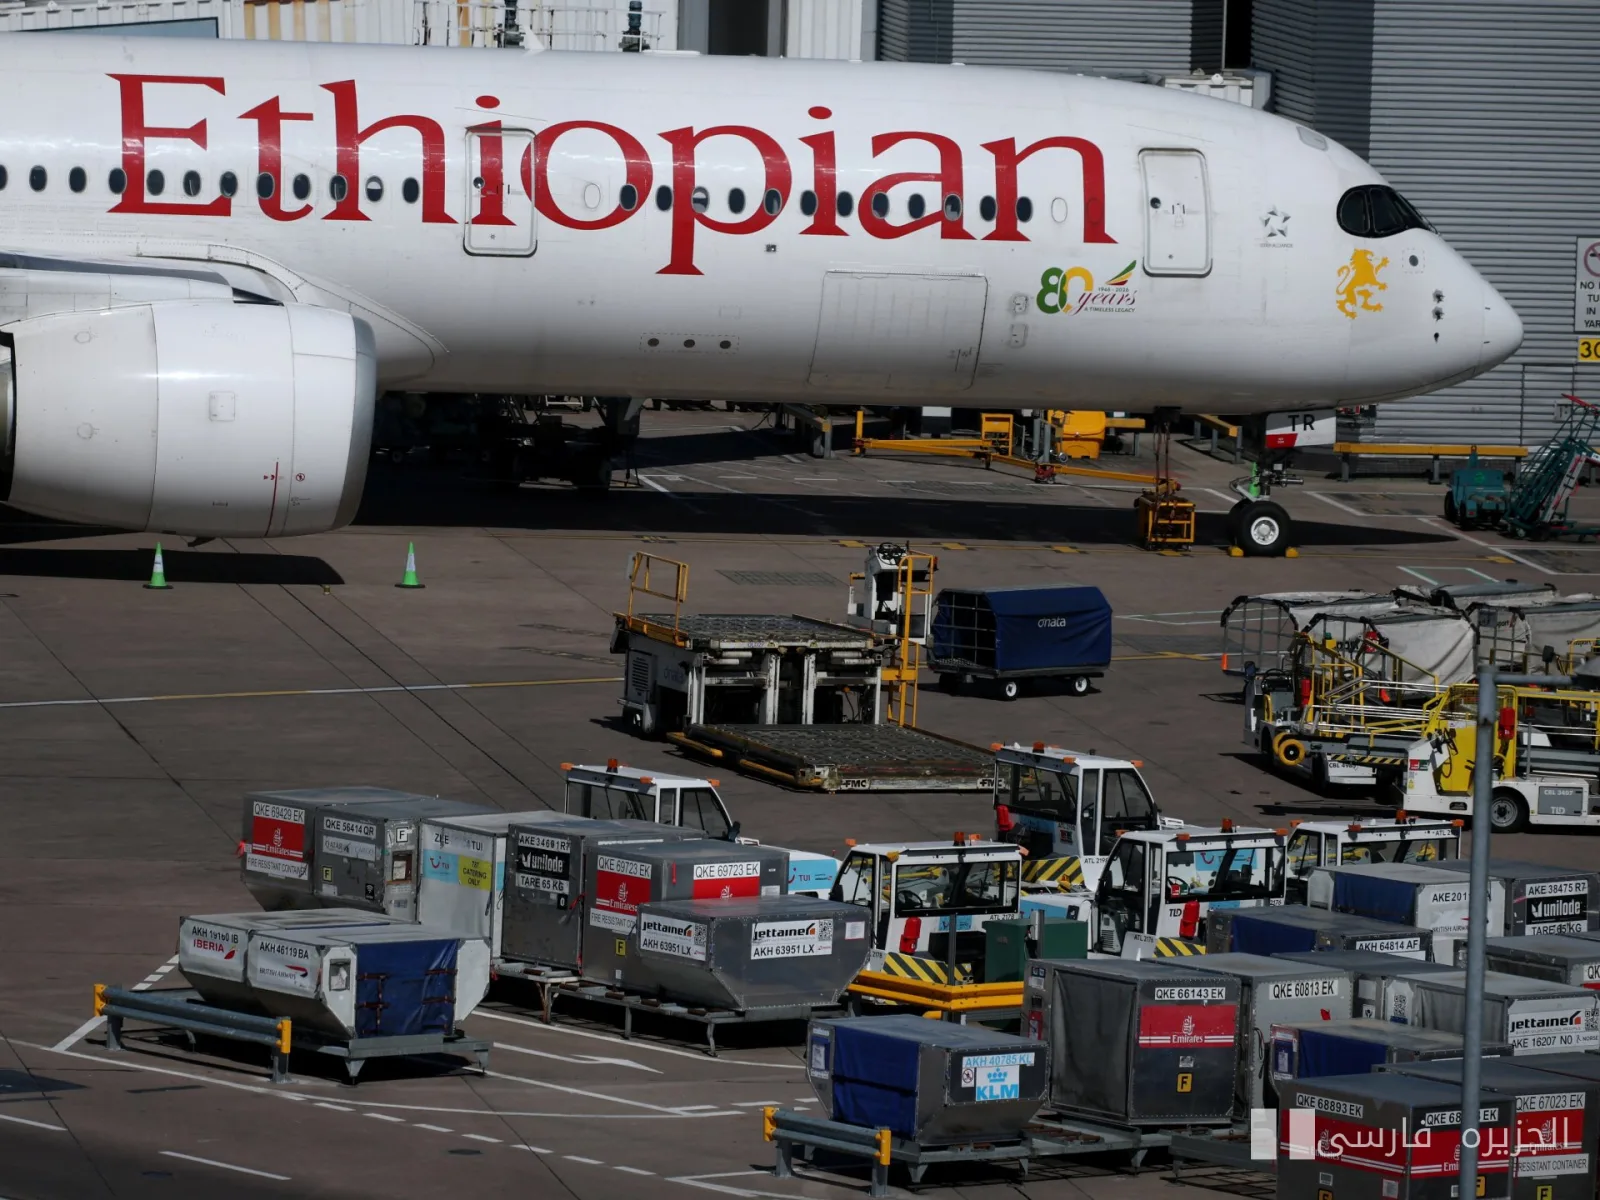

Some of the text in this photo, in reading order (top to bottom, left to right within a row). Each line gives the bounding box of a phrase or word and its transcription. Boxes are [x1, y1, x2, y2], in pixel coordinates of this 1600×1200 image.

[105, 73, 1119, 275] Ethiopian
[1037, 267, 1093, 315] 80
[1580, 281, 1595, 290] NO
[1069, 291, 1138, 316] years
[1586, 307, 1597, 315] IN
[1288, 414, 1315, 432] TR
[254, 803, 304, 822] QKE 69429 EK
[1550, 806, 1566, 815] TLD
[325, 819, 374, 836] QKE 56414 QR
[519, 835, 535, 846] AKE
[265, 844, 290, 856] Emirates
[531, 852, 564, 873] unilode
[598, 856, 651, 877] QKE 69723 EK
[694, 862, 760, 878] QKE 69723 EK
[462, 868, 487, 879] CATERING
[798, 874, 810, 882] TUI
[521, 876, 564, 891] TARE 65 KG
[1528, 882, 1587, 896] AKE 38475 R7
[1432, 892, 1450, 903] AKE
[1169, 909, 1182, 917] TLD
[1543, 899, 1581, 917] unilode
[601, 913, 626, 928] RESISTANT
[641, 919, 693, 937] jettainer
[191, 926, 209, 938] AKH
[231, 933, 239, 943] IB
[752, 922, 816, 941] jettainer
[1531, 924, 1554, 935] TARE
[1567, 923, 1582, 933] KG
[193, 939, 225, 953] IBERIA
[259, 942, 309, 959] AKH 46119 BA
[642, 938, 692, 957] AKH 63951 LX
[753, 946, 773, 958] AKH
[775, 945, 801, 956] 63951
[801, 944, 815, 954] LX
[1358, 940, 1419, 951] AKH 64814 AF
[1156, 988, 1224, 1000] QKE 66143 EK
[1273, 980, 1334, 999] QKE 60813 EK
[1510, 1010, 1582, 1033] jettainer
[1172, 1034, 1203, 1044] Emirates
[1511, 1039, 1529, 1049] AKE
[1532, 1037, 1556, 1047] 16207
[1559, 1035, 1573, 1045] NO
[965, 1052, 1032, 1068] AKH 40785 KL
[976, 1084, 1019, 1100] KLM
[1297, 1093, 1362, 1117] QKE 68893 EK
[1516, 1094, 1584, 1111] QKE 67023 EK
[1426, 1112, 1448, 1126] QKE
[1484, 1109, 1498, 1120] EK
[1552, 1158, 1588, 1171] CONTAINER
